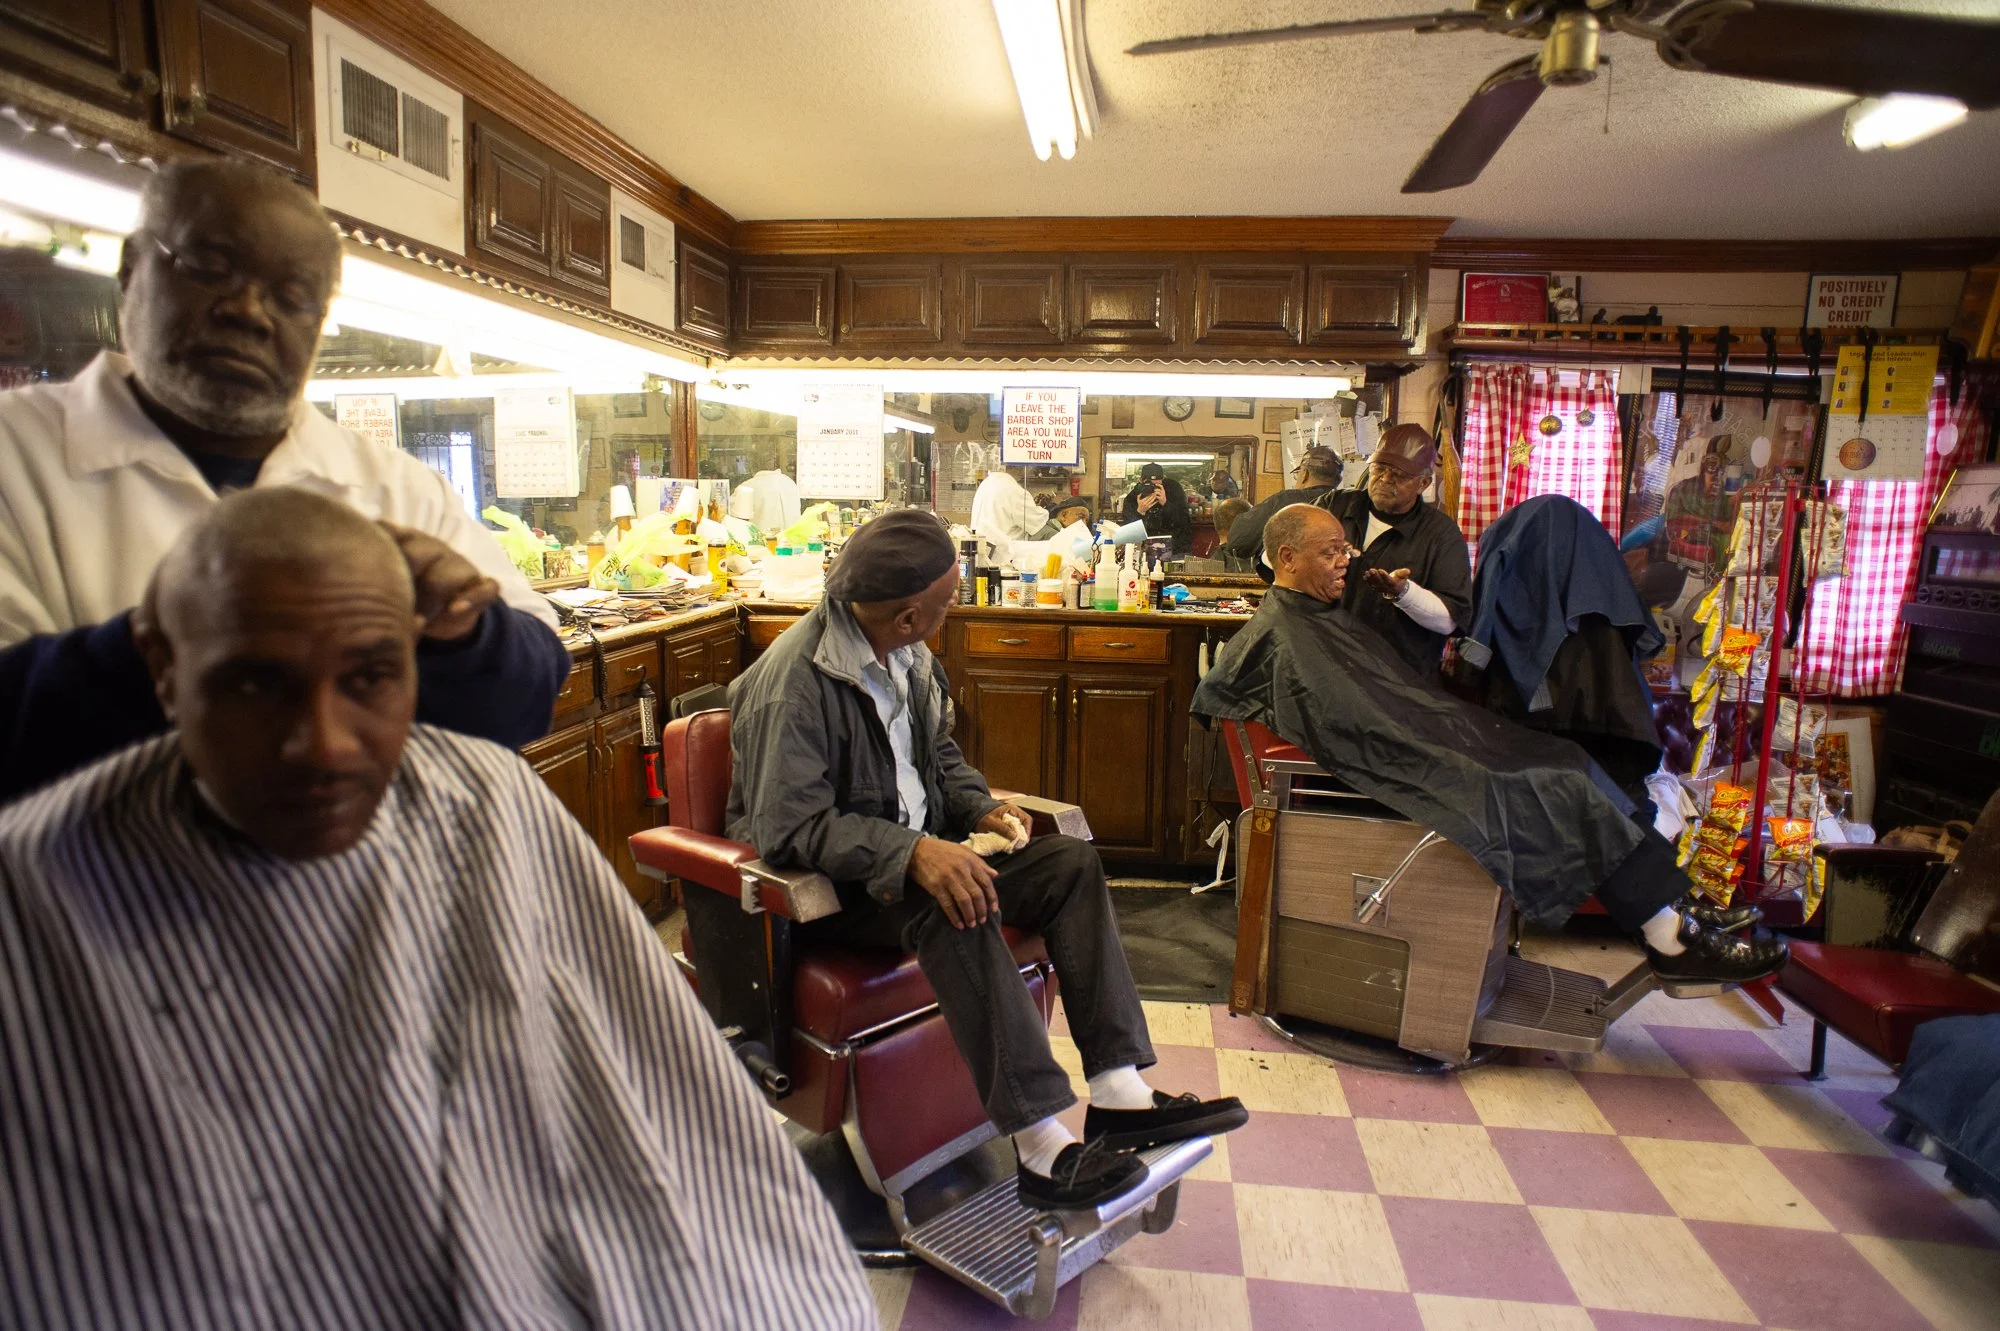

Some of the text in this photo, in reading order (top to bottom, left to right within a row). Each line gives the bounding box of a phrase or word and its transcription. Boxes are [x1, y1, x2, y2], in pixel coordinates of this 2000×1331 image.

[1819, 280, 1888, 293] POSITIVELY
[1818, 295, 1885, 308] NO CREDIT
[1828, 310, 1872, 323] CREDIT
[1025, 392, 1057, 402] IF YOU
[1015, 404, 1066, 414] LEAVE THE
[1007, 415, 1074, 426] BARBER SHOP
[1007, 427, 1074, 438] AREA YOU WILL
[1012, 439, 1067, 449] LOSE YOUR
[1027, 450, 1052, 460] TURN
[1921, 641, 1962, 659] SNACK
